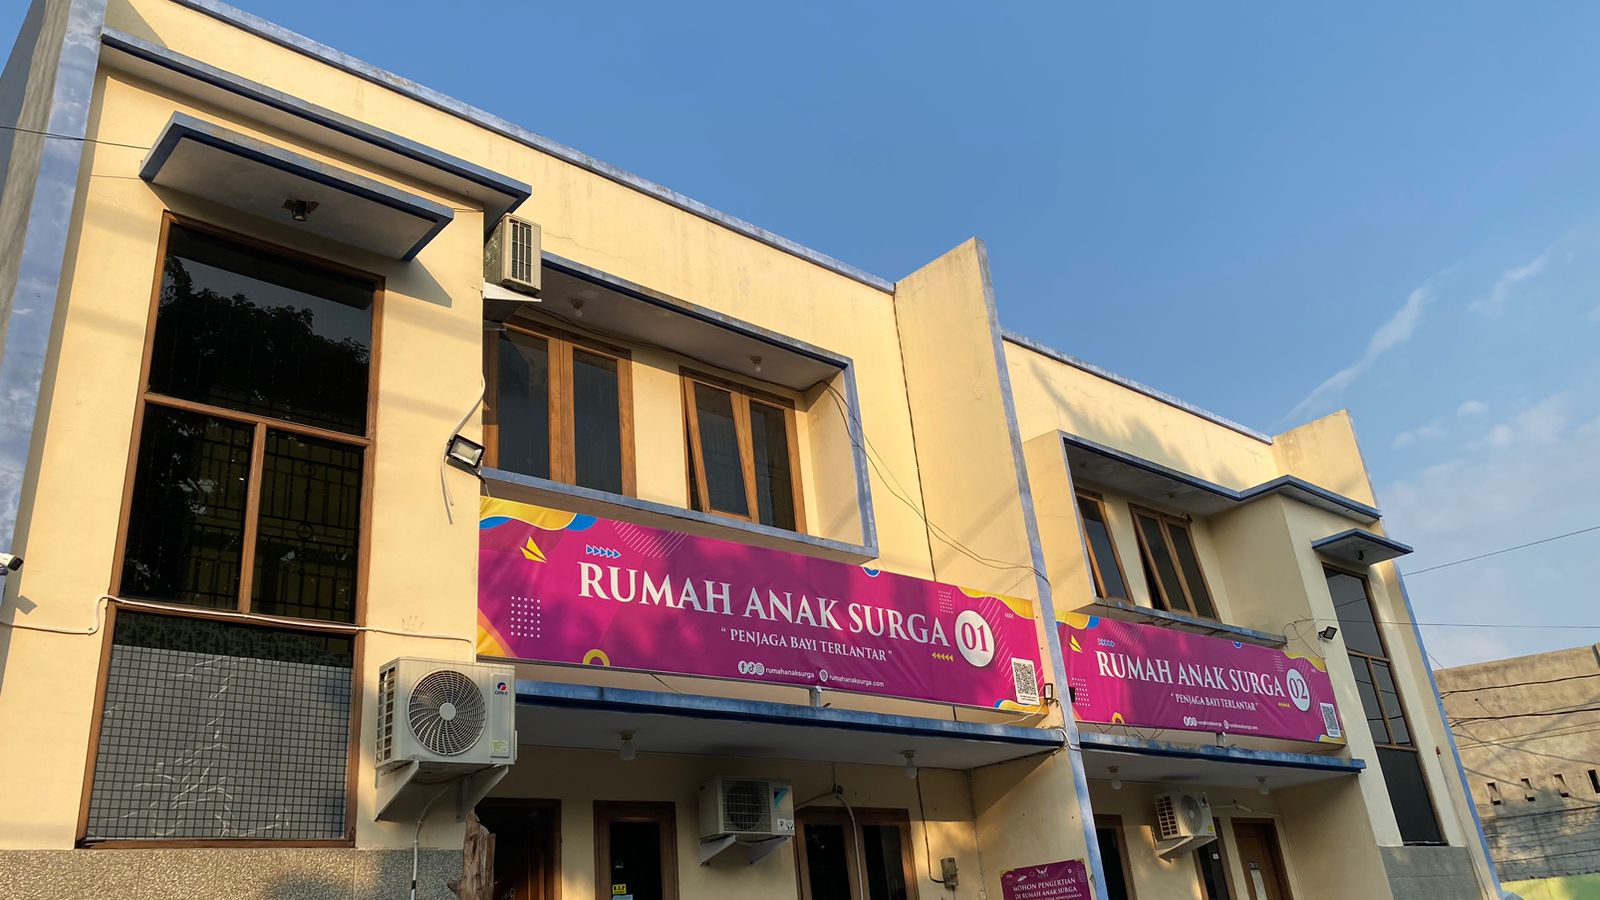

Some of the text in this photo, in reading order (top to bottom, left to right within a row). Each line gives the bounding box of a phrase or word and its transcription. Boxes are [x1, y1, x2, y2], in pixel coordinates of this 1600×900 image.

[577, 561, 951, 647] RUMAH ANAK SURGA
[730, 628, 788, 647] PENJAGA
[790, 636, 817, 651] BAYI
[819, 640, 887, 661] TERLANTAR
[961, 622, 990, 652] 01
[765, 667, 815, 679] rumahanaksurga
[829, 674, 885, 687] rumahanaksurga.com
[1094, 650, 1287, 698] RUMAH ANAK SURGA
[1289, 677, 1308, 700] 02
[1175, 693, 1206, 706] PENJAGA
[1206, 696, 1220, 708] BAYI
[1220, 698, 1257, 711] TERLANTAR
[1012, 877, 1076, 892] MOHON PENGERTIAN
[1022, 890, 1041, 899] RUMAH
[1042, 888, 1057, 897] ANAK
[1057, 886, 1078, 894] SURGA
